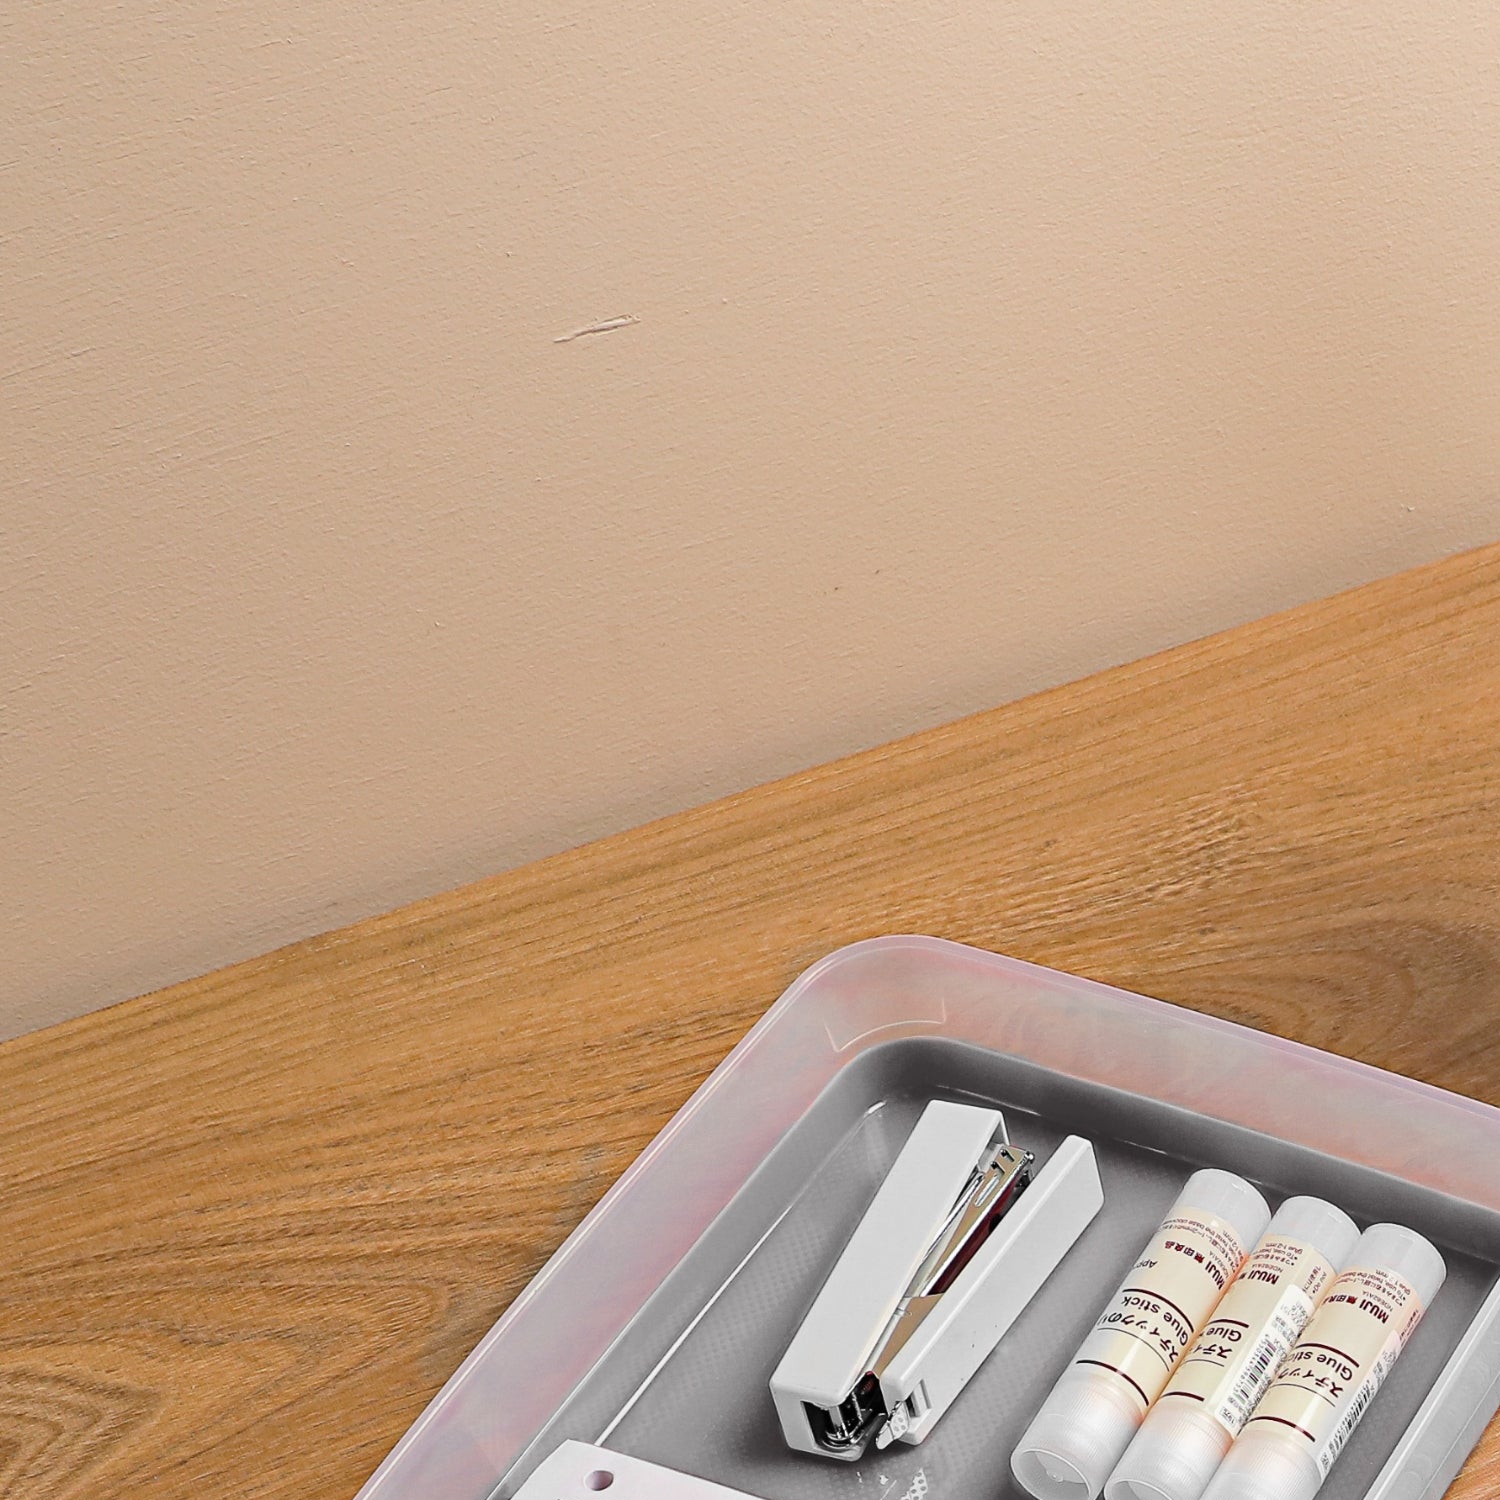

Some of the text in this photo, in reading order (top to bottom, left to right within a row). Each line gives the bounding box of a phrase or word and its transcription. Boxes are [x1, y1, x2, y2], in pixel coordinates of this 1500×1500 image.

[1164, 1240, 1205, 1264] 無印良品
[1205, 1260, 1225, 1290] MUJI
[1247, 1270, 1280, 1285] MUJI
[1122, 1296, 1189, 1347] Glue stick
[1359, 1298, 1390, 1324] MUJI
[1206, 1326, 1242, 1342] Glue
[1316, 1353, 1354, 1381] Glue
